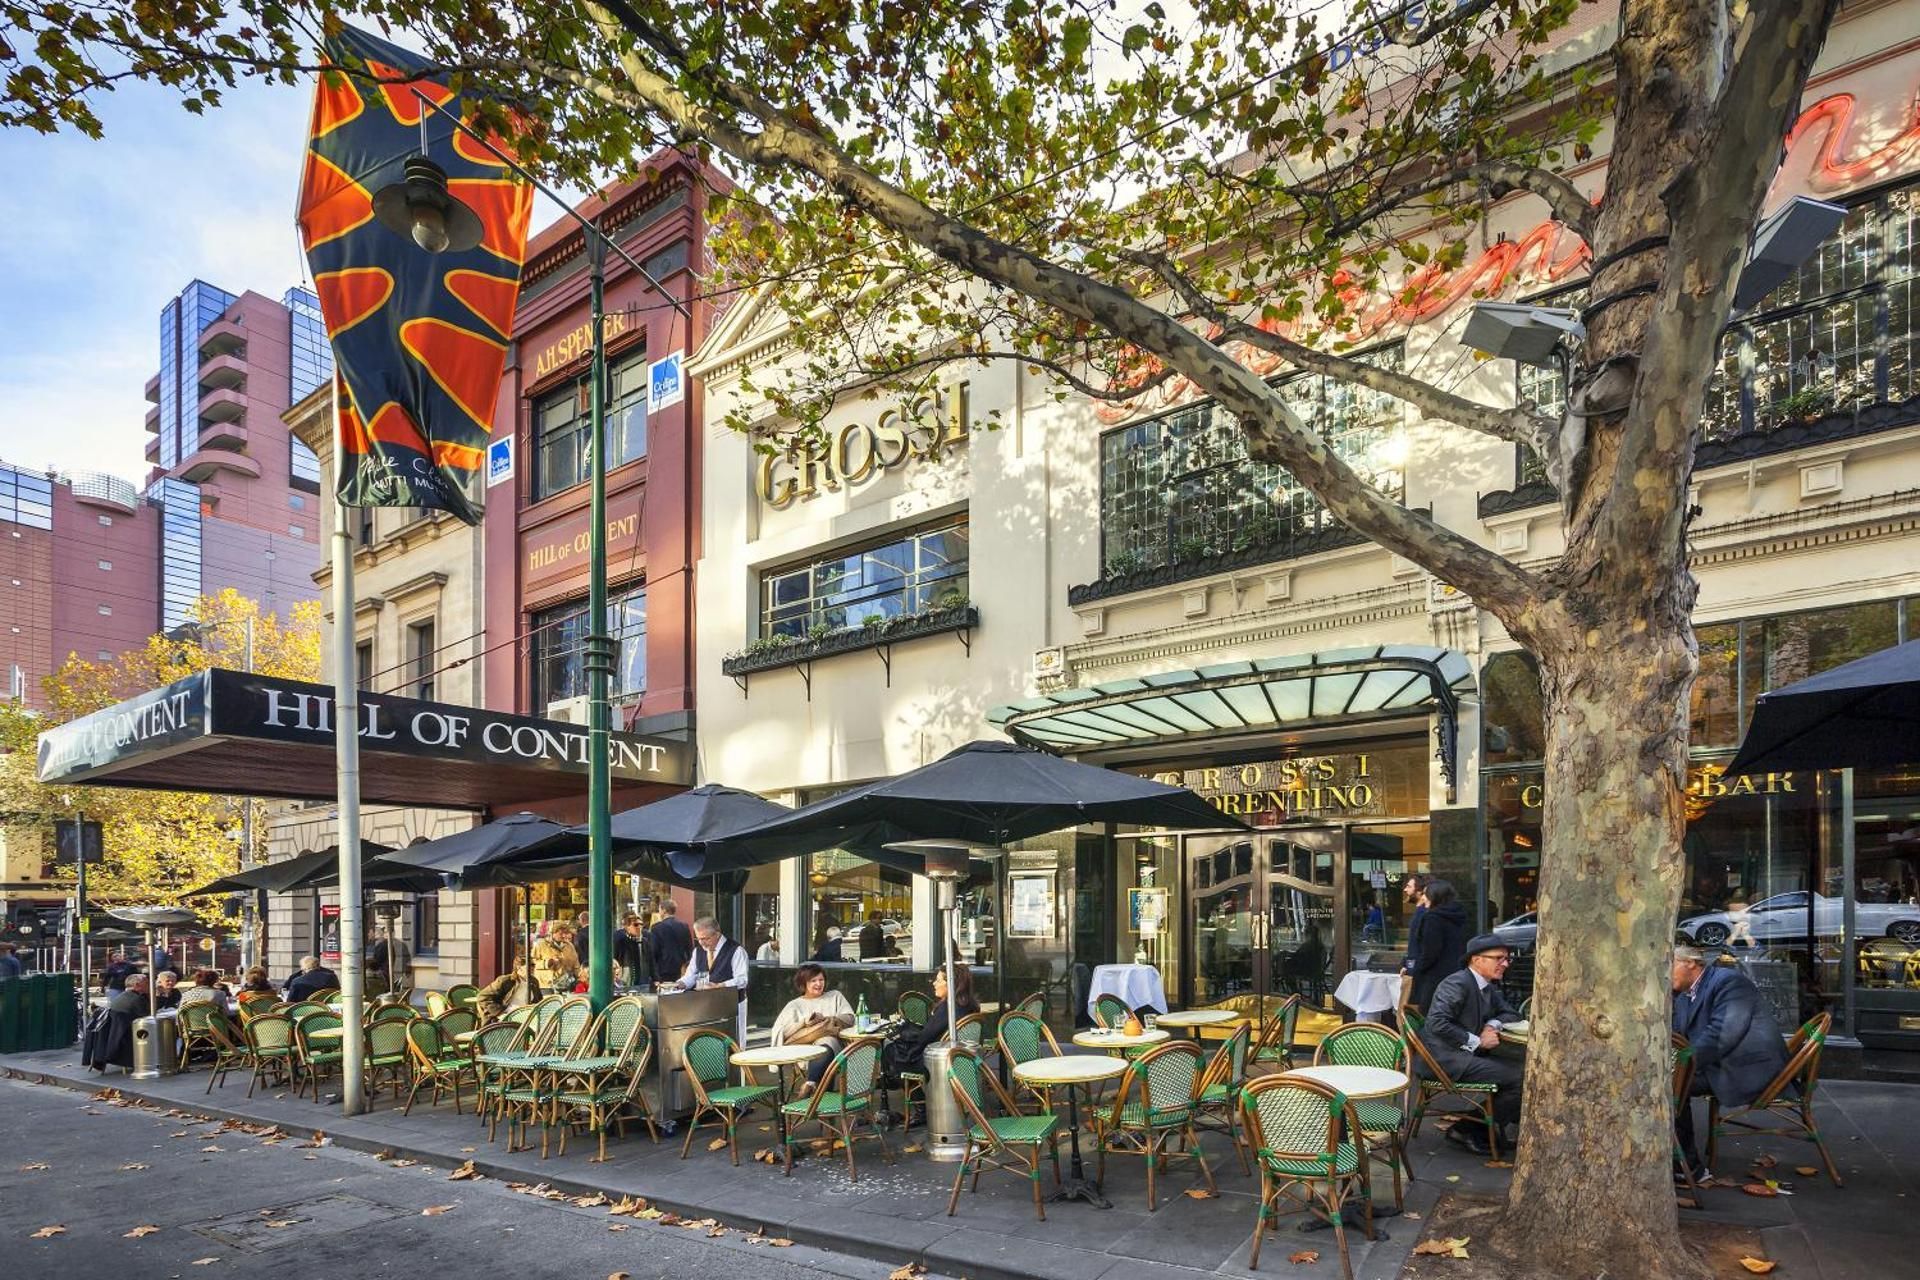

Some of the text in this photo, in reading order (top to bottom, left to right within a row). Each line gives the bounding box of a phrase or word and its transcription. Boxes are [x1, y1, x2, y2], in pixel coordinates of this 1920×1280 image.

[558, 310, 624, 364] SPENER
[756, 381, 970, 506] GROSSI
[530, 514, 636, 571] HILL OF COENT
[103, 690, 190, 750] CONTENT
[262, 688, 396, 740] HIL
[411, 712, 470, 748] OF
[1164, 754, 1370, 790] GROSSI
[1205, 784, 1372, 815] ORENTINO
[1699, 772, 1797, 797] BAR
